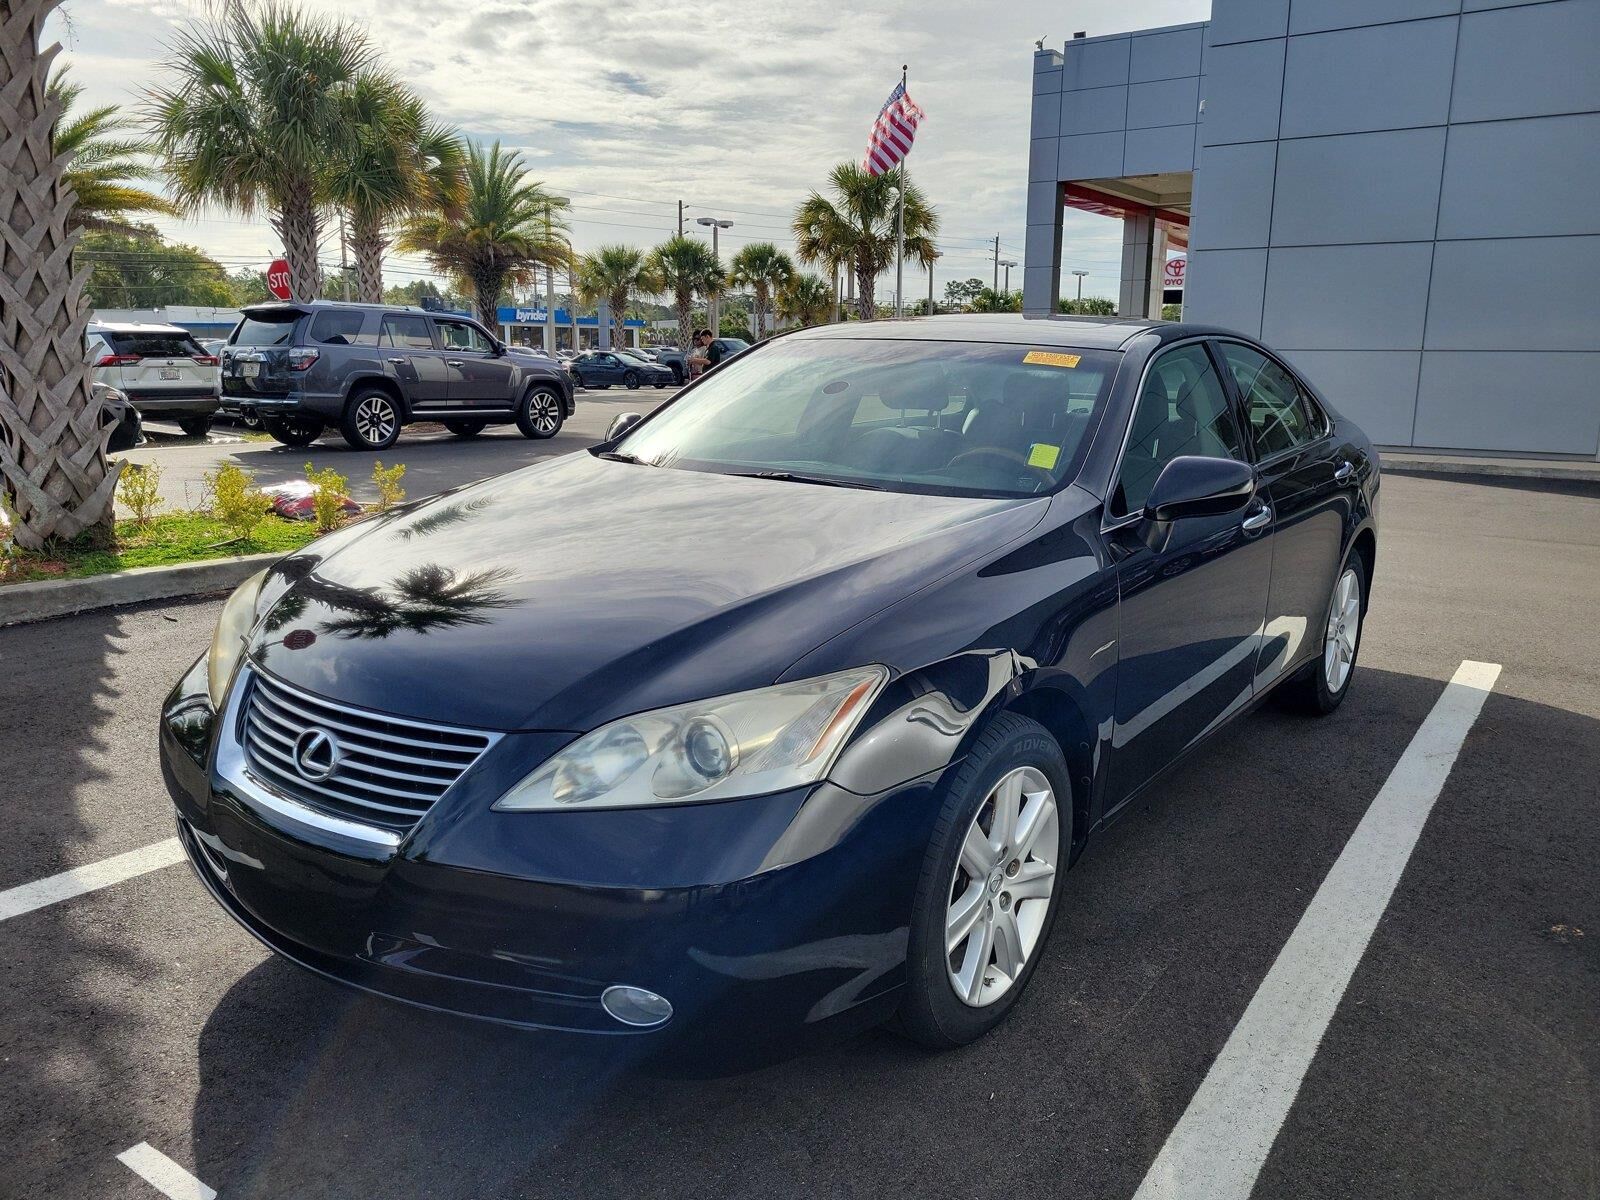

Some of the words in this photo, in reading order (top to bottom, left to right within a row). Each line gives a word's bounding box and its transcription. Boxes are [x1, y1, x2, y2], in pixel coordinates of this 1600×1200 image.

[270, 272, 289, 288] STO
[1164, 278, 1183, 286] OYO
[516, 309, 547, 322] byrider
